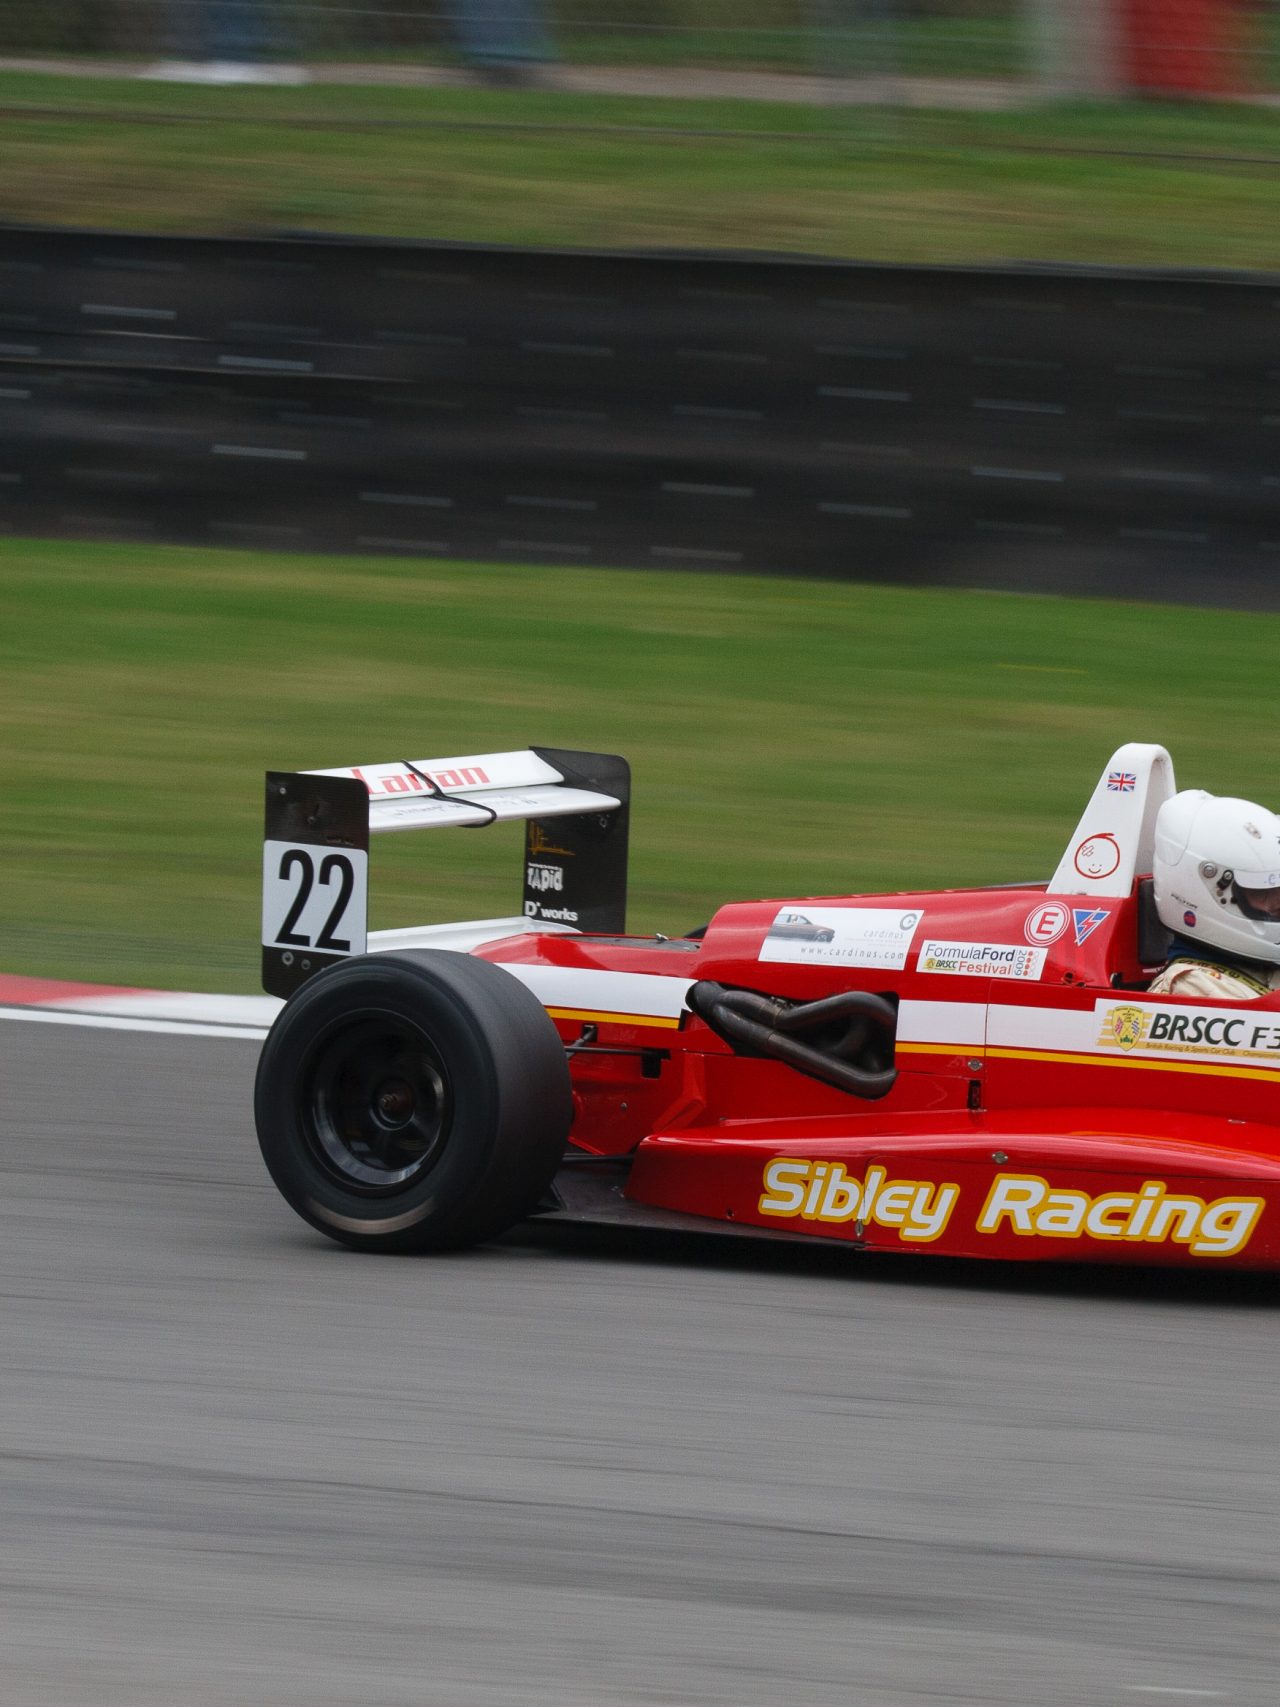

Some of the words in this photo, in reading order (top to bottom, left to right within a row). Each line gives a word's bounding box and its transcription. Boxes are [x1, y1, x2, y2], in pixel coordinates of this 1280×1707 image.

[274, 849, 355, 952] 22
[863, 929, 905, 940] cardinus
[1036, 911, 1059, 935] E
[800, 946, 905, 960] www.cardinus.com
[925, 943, 1016, 962] FormulaFord
[1014, 949, 1028, 976] 2009
[936, 960, 959, 970] BRSCC
[958, 961, 1013, 975] Festival
[1149, 1013, 1246, 1047] BRSCC
[760, 1160, 957, 1240] Sibley
[979, 1176, 1262, 1254] Racing
